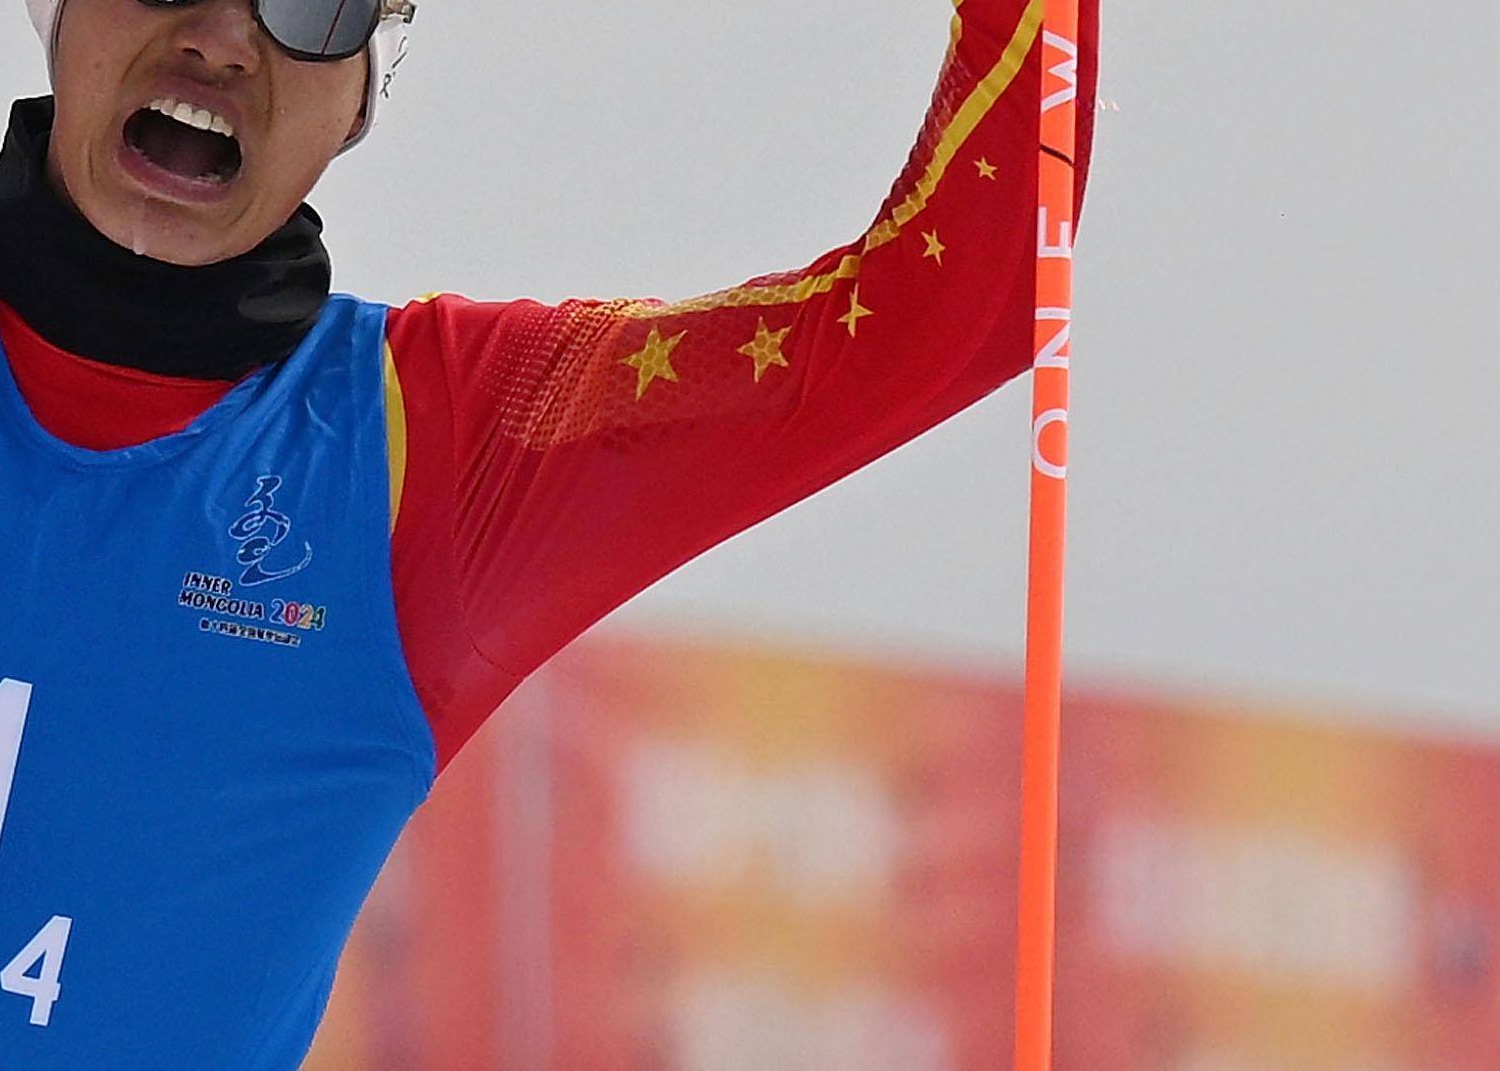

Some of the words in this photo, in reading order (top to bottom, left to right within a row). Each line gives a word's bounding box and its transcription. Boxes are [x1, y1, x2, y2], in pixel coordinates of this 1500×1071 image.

[1031, 220, 1073, 480] ONE
[183, 572, 232, 596] INNER
[178, 589, 265, 620] MONGOLIA
[269, 598, 326, 631] 2024
